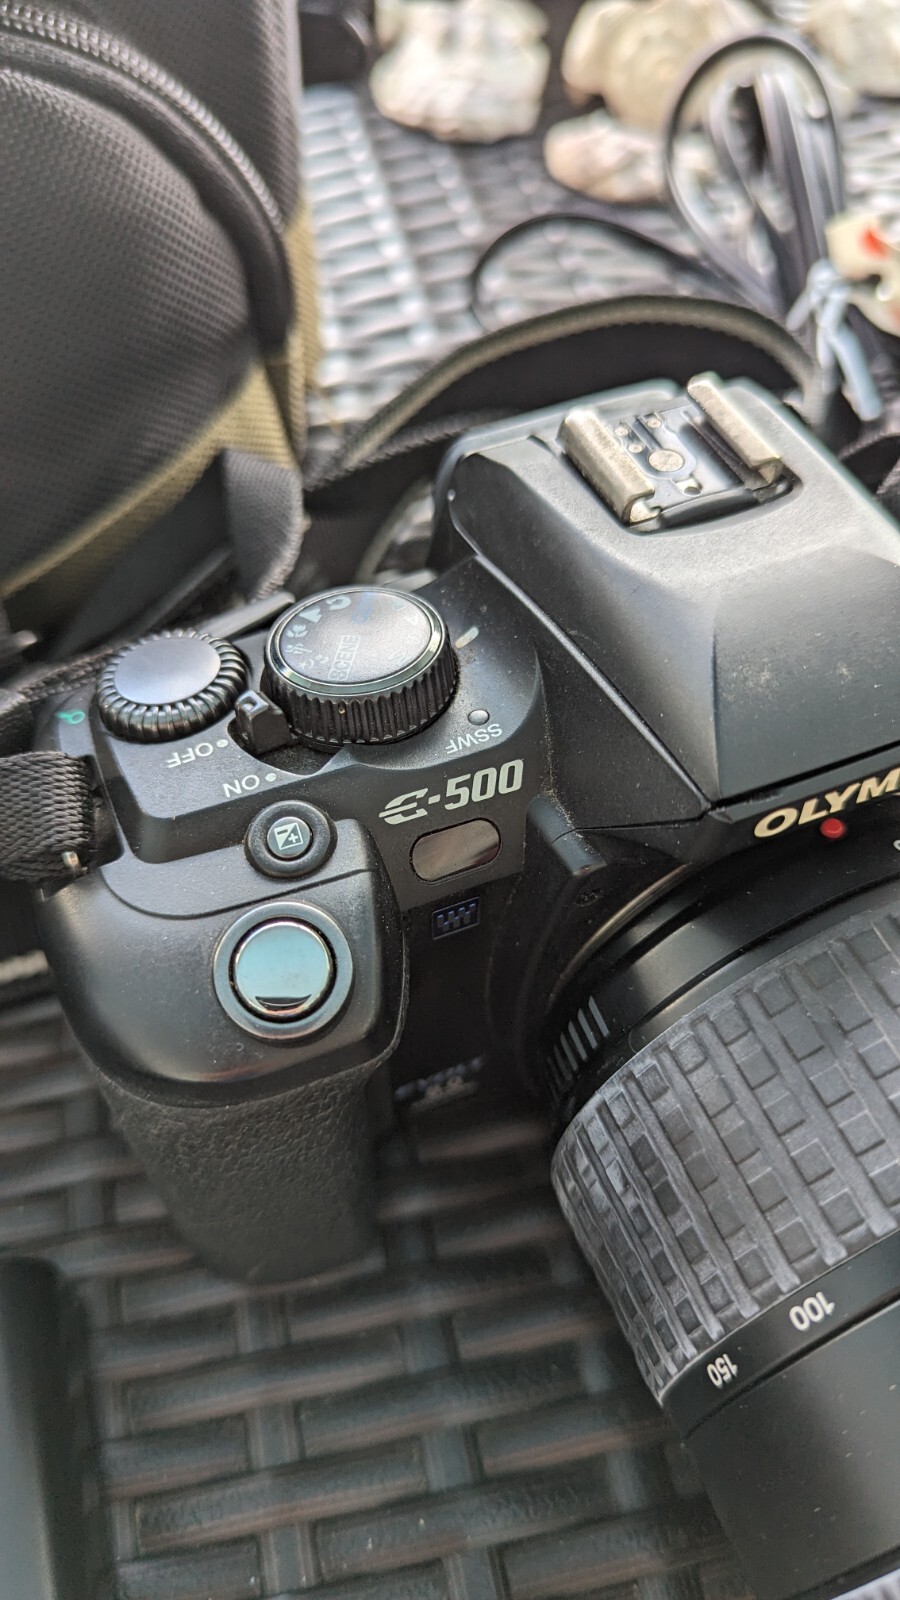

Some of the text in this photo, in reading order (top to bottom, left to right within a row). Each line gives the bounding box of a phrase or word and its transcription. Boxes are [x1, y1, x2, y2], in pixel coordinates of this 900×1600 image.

[330, 635, 359, 680] SCENE
[166, 742, 214, 768] OFF
[445, 723, 503, 754] SSWF
[222, 774, 260, 798] ON
[378, 758, 524, 825] E-500
[753, 766, 900, 838] OLYM
[789, 1291, 835, 1331] 100
[707, 1353, 738, 1388] 150
